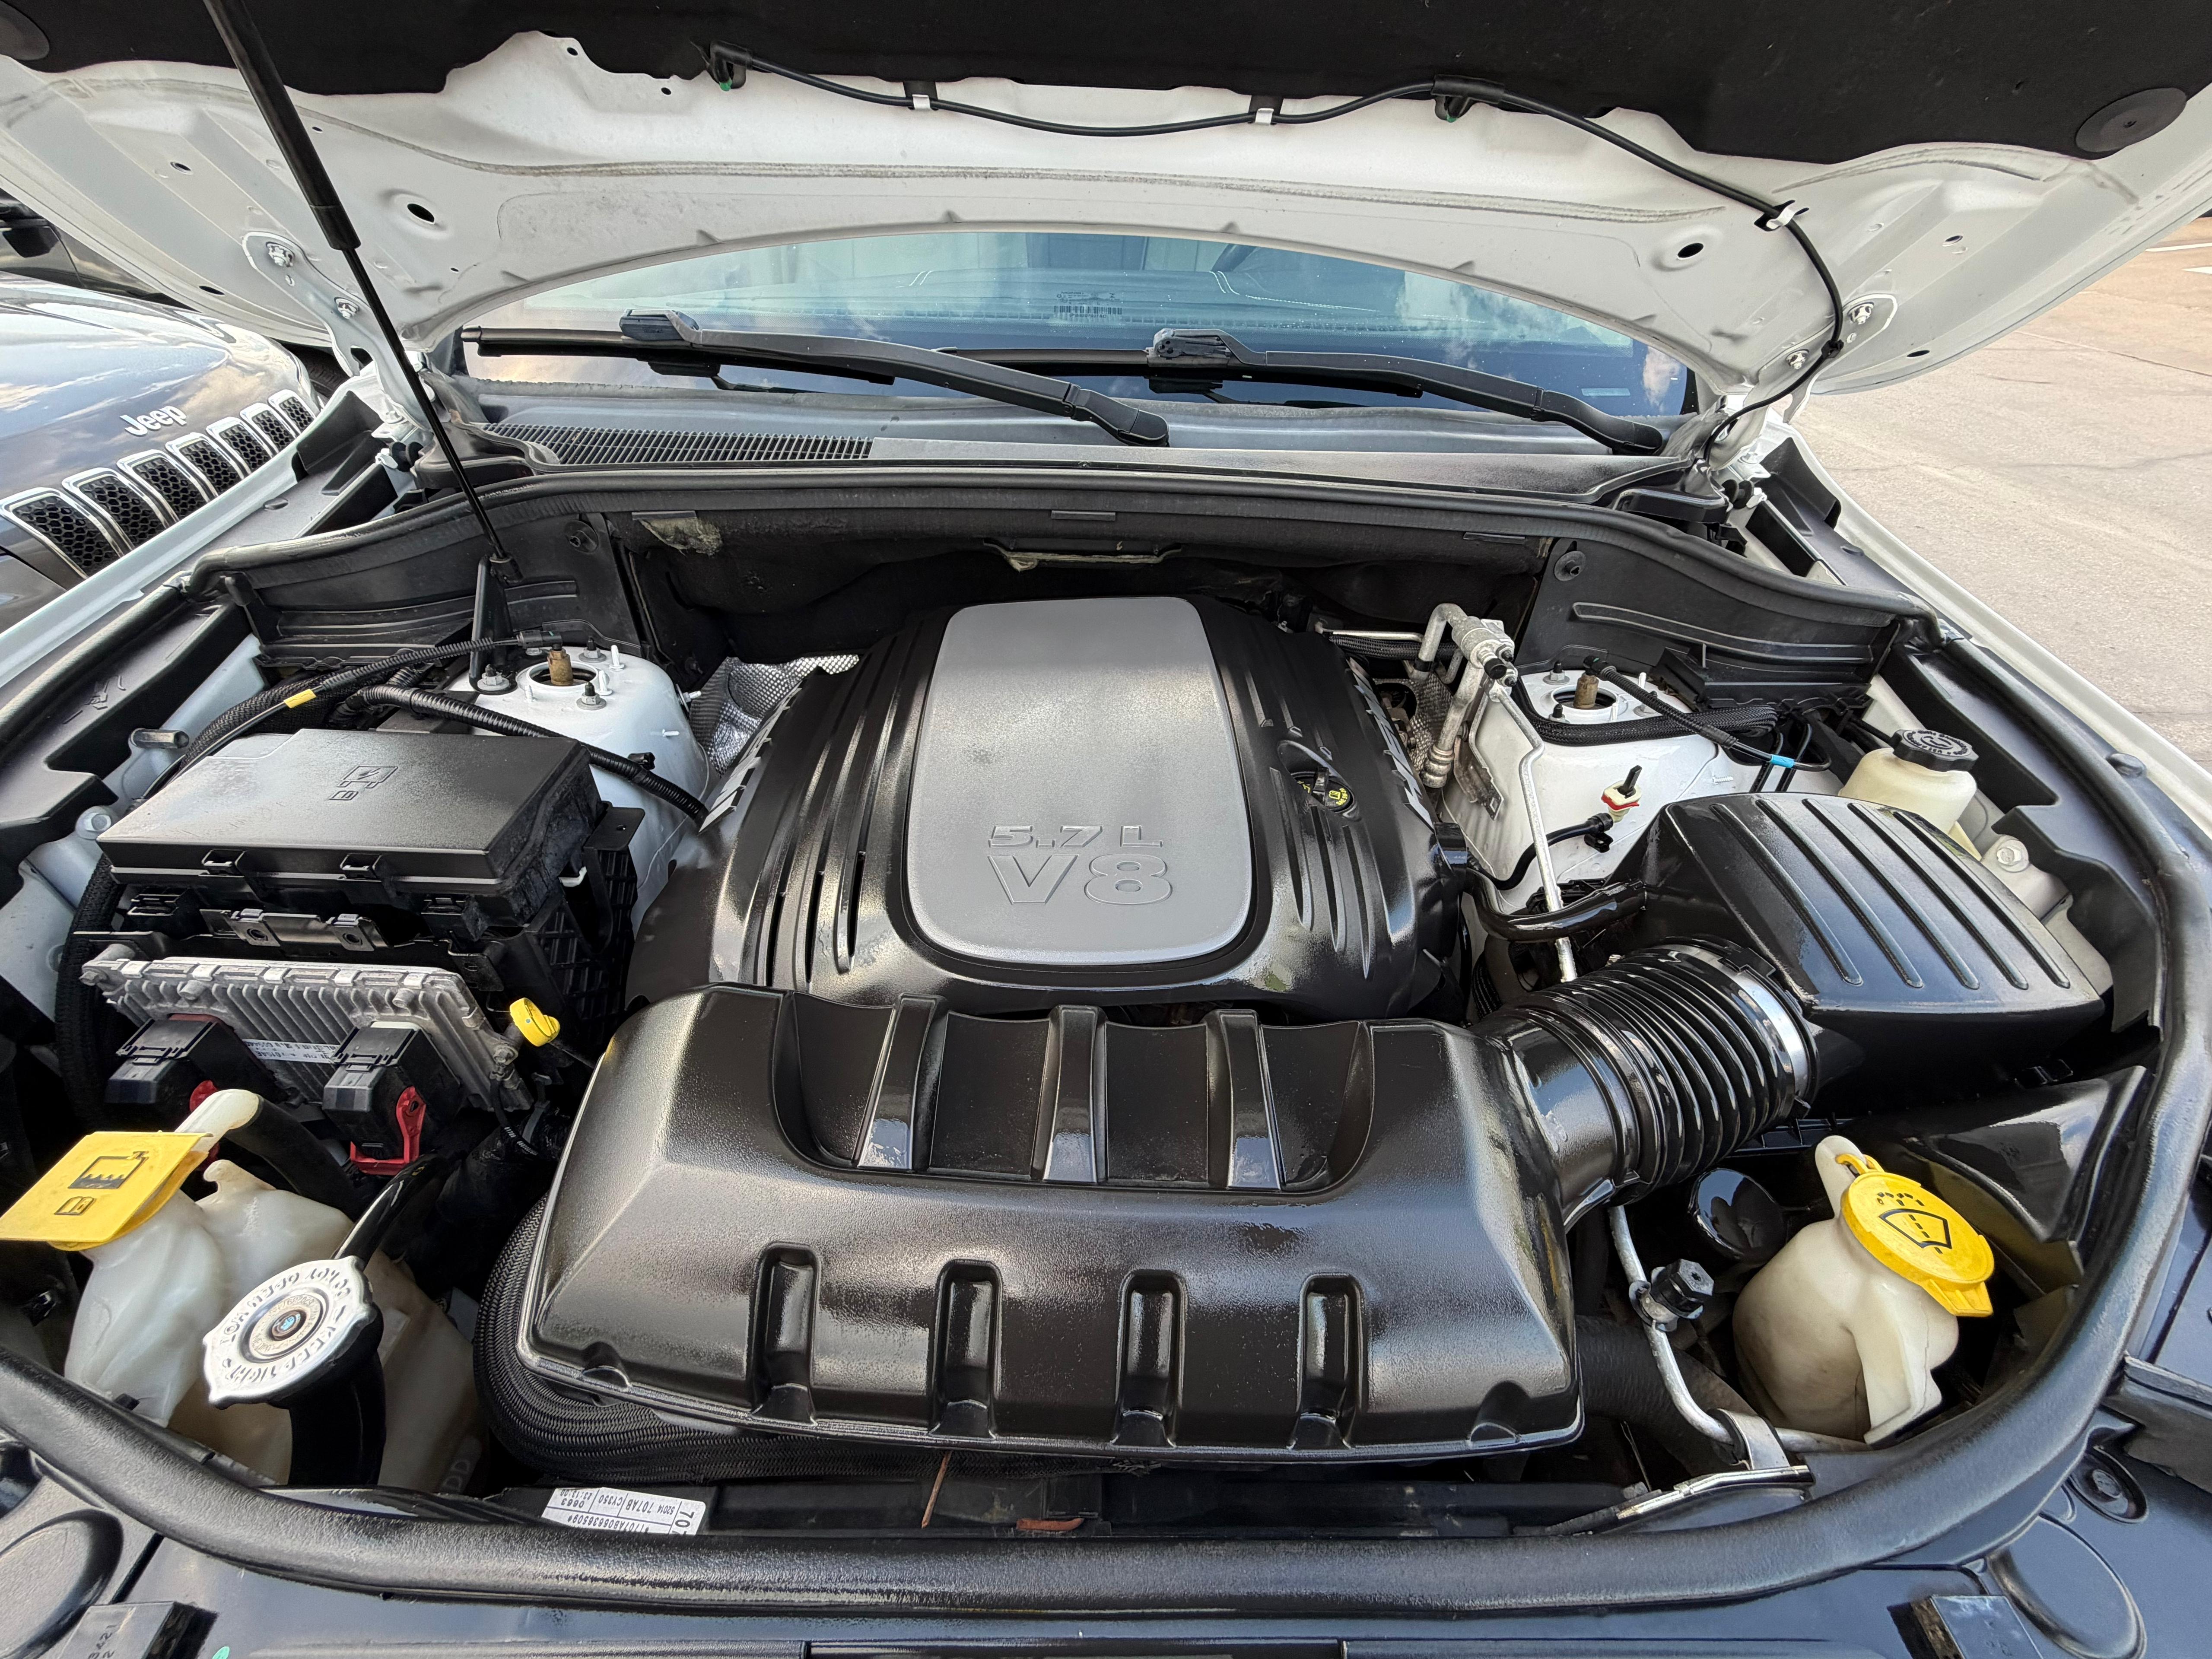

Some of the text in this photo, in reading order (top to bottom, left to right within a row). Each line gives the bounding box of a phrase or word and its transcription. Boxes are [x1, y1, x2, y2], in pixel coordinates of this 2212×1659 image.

[120, 406, 187, 436] Jeep
[988, 854, 1173, 905] V8
[247, 1272, 300, 1308] OPEN
[284, 1325, 337, 1370] KEEP
[598, 1494, 623, 1506] CY350
[626, 1499, 676, 1515] 52014 707AB
